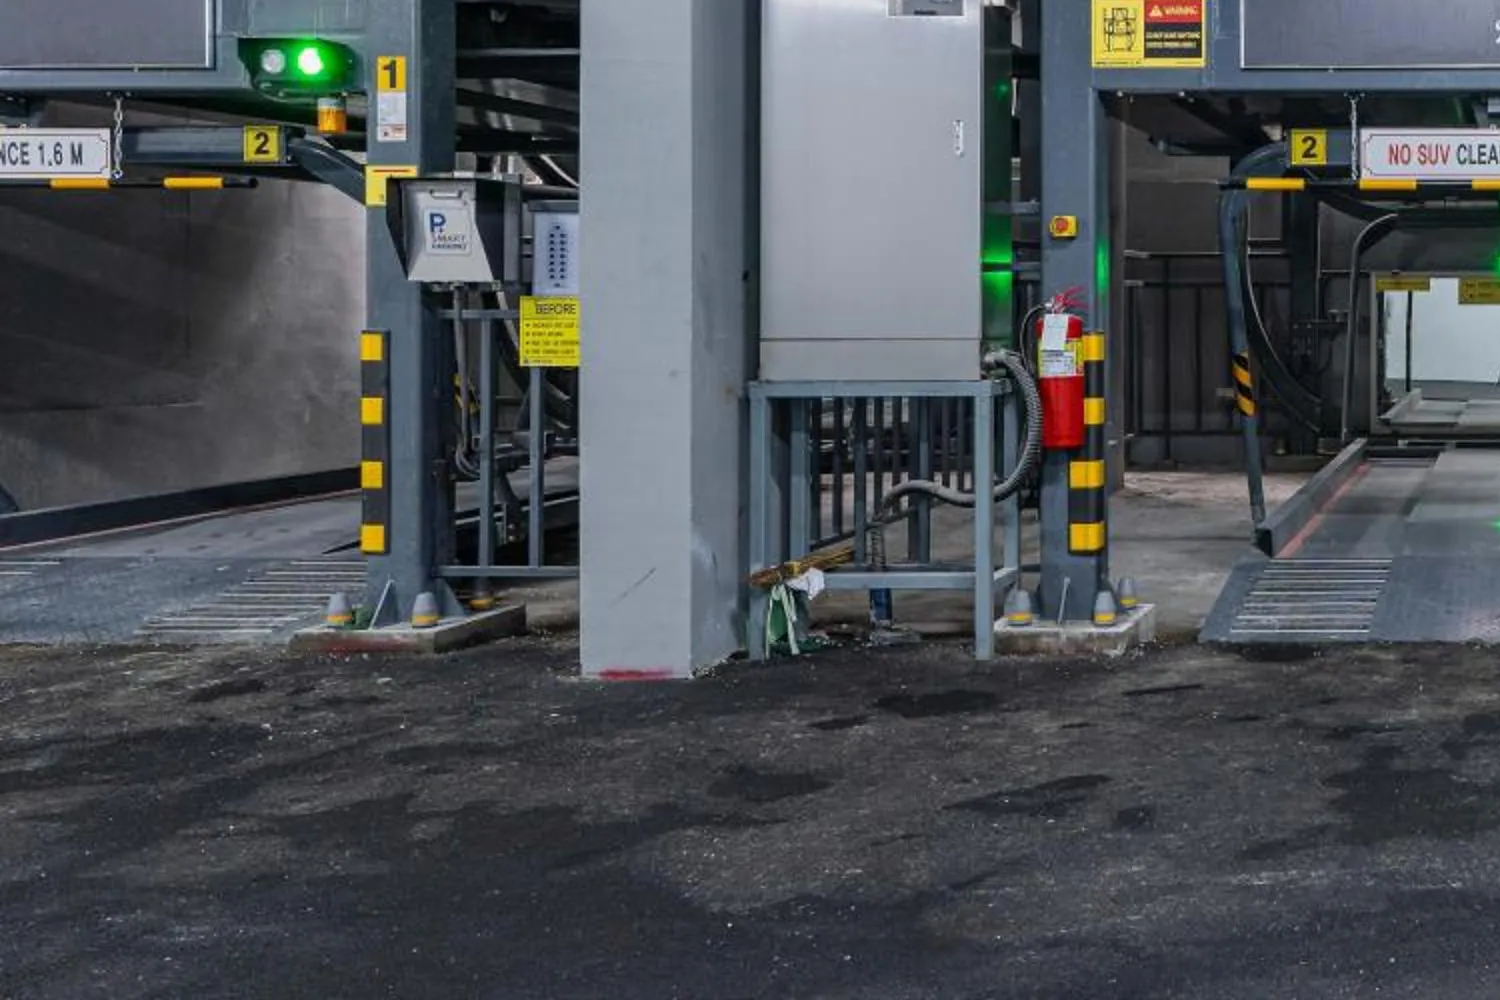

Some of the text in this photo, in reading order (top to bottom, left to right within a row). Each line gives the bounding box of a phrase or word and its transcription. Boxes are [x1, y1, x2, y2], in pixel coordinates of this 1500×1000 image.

[382, 60, 397, 88] 1
[38, 142, 63, 167] 1.6
[71, 142, 83, 165] M
[254, 132, 269, 155] 2
[1301, 136, 1317, 158] 2
[1388, 144, 1411, 166] NO
[1417, 144, 1451, 166] SUV
[430, 213, 447, 233] P
[535, 303, 577, 315] BEFORE
